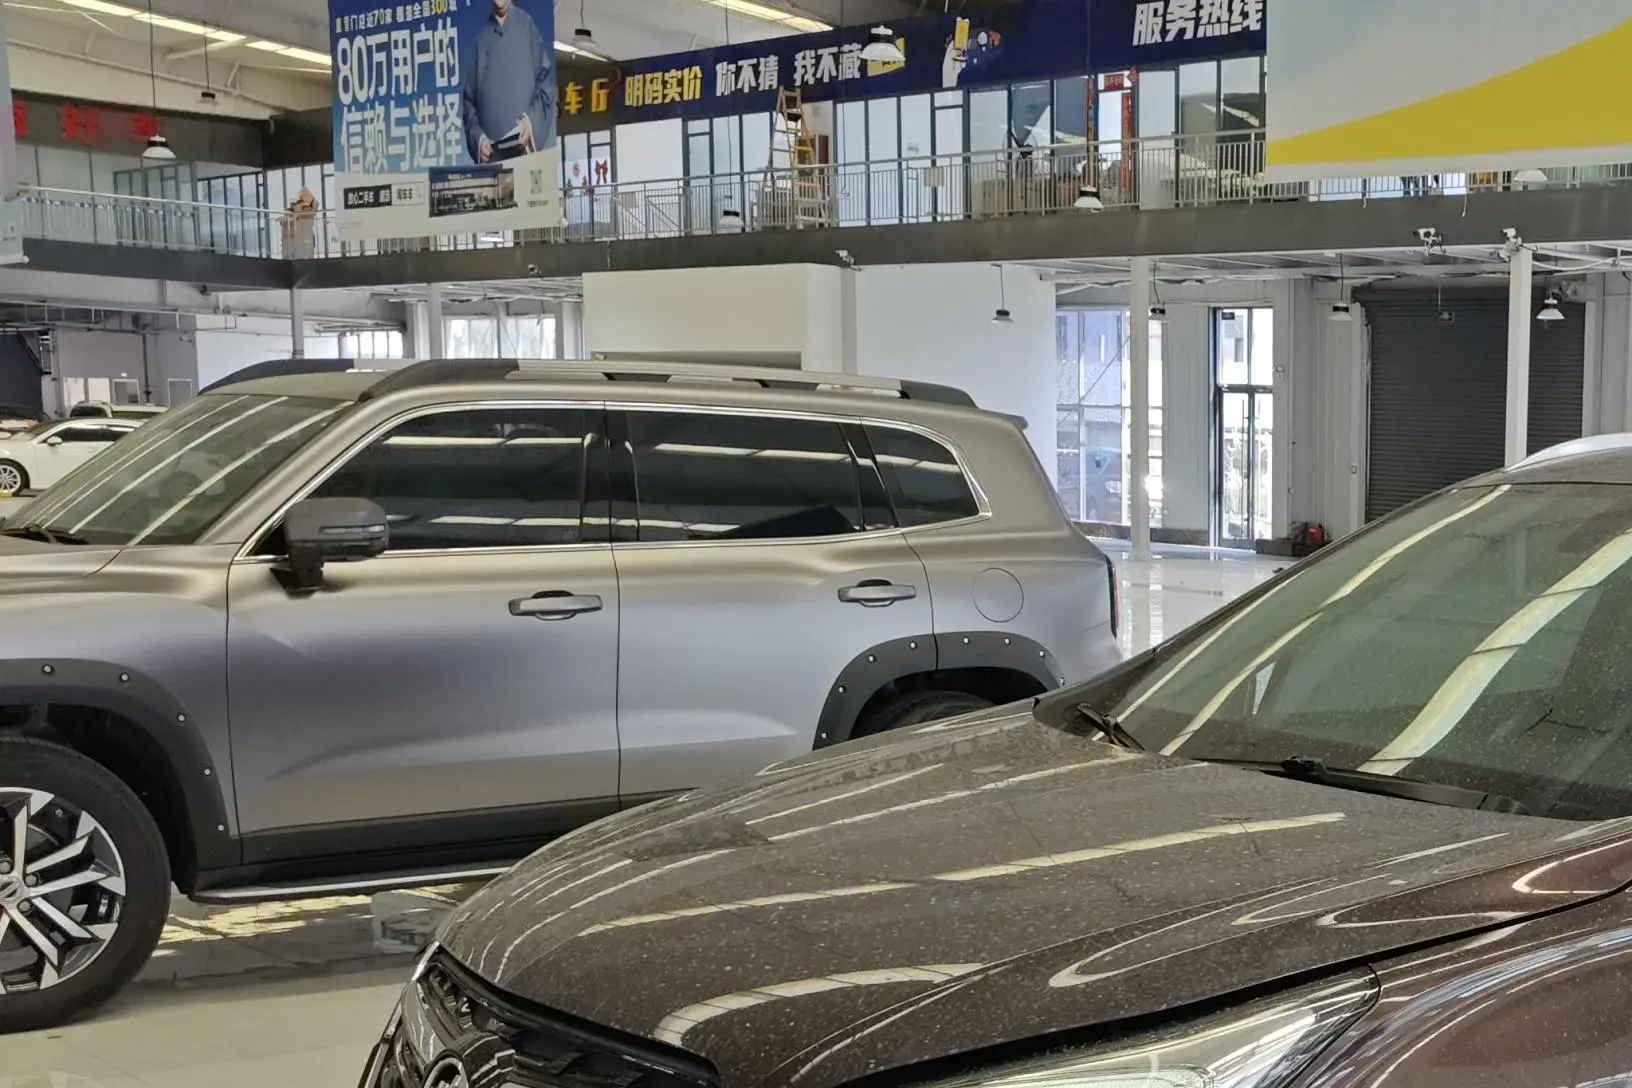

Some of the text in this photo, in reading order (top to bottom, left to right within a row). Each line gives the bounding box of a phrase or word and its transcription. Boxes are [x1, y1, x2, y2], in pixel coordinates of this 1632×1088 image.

[1132, 0, 1263, 46] 服务热线
[337, 16, 460, 105] 80万用户的
[624, 43, 863, 107] 明码实价 你不猜 我不藏
[556, 77, 610, 117] 车厅
[341, 92, 462, 175] 信赖与选择
